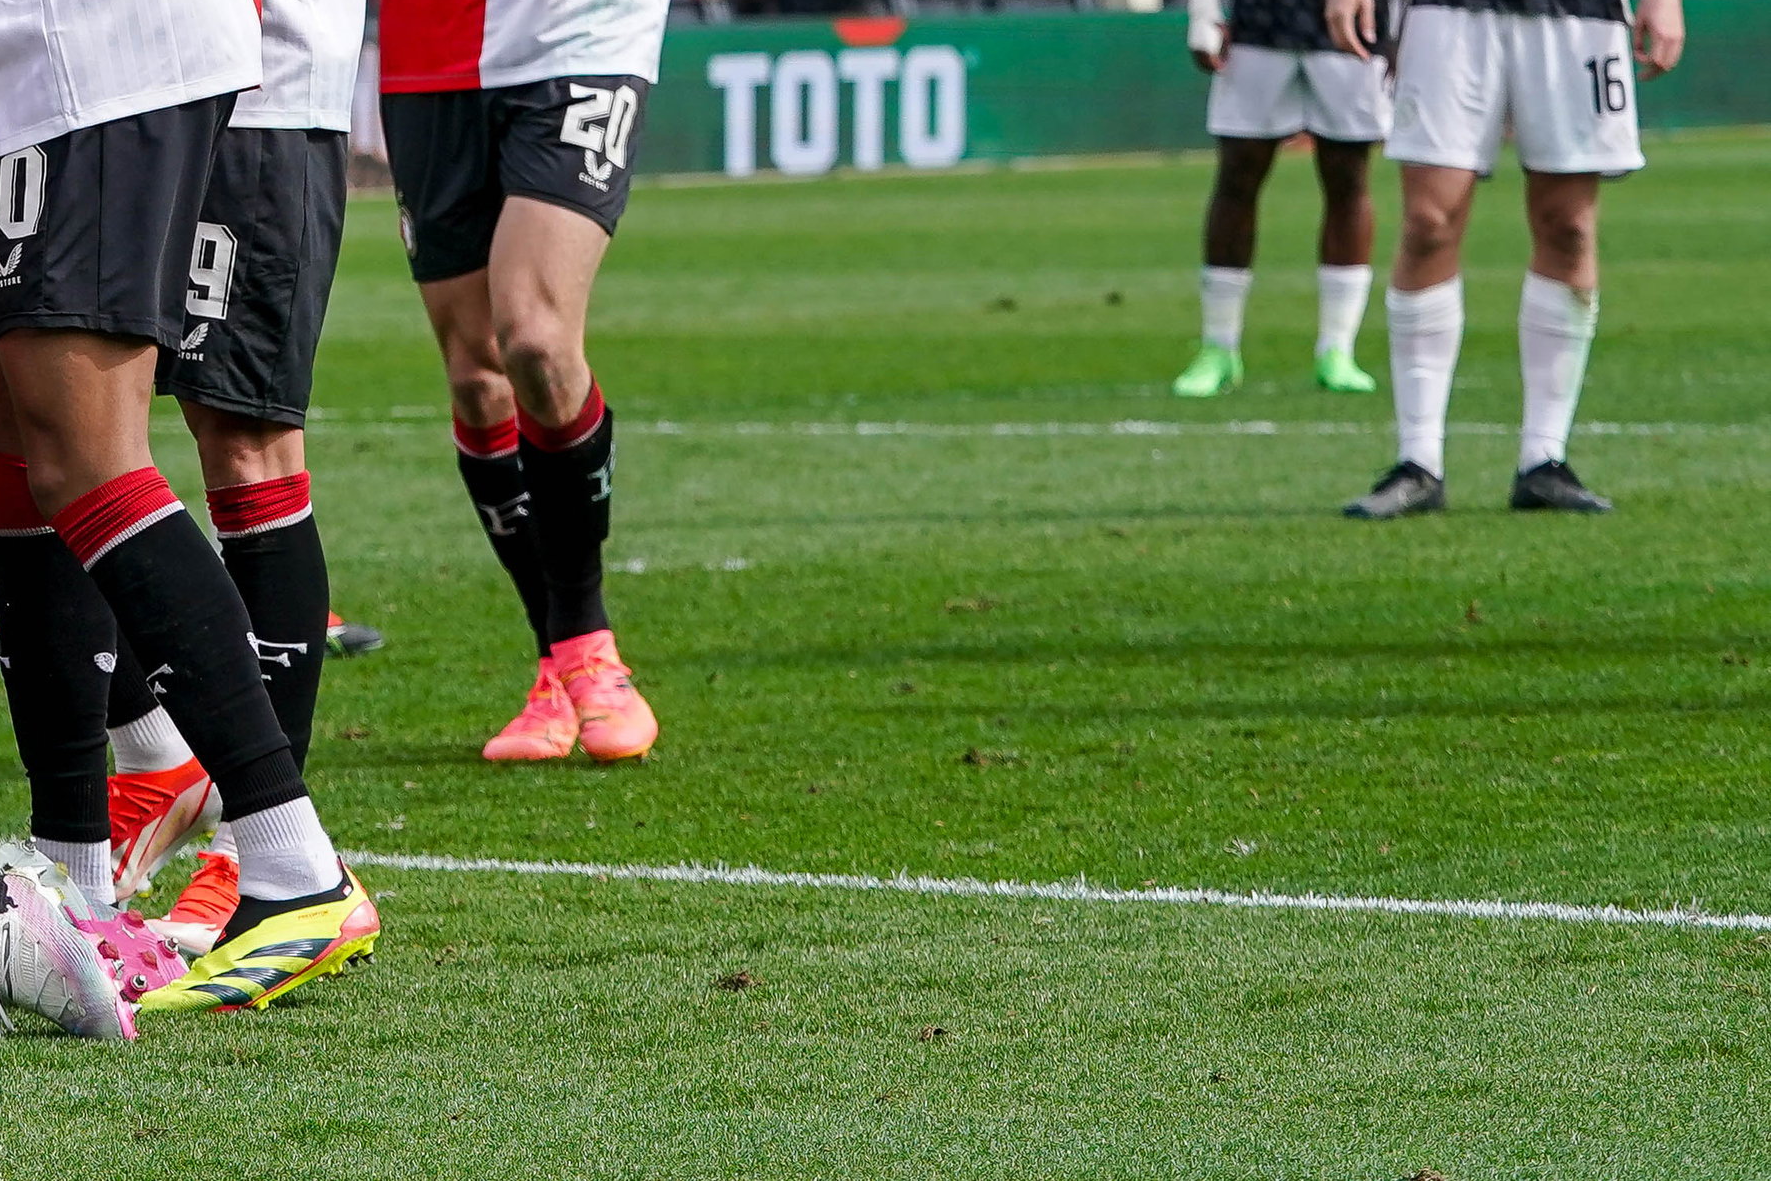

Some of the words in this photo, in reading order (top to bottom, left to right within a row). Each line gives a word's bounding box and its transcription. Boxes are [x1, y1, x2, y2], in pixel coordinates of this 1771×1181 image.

[560, 83, 638, 169] 20
[708, 45, 968, 178] TOTO
[1585, 53, 1627, 115] 16
[185, 221, 238, 320] 9
